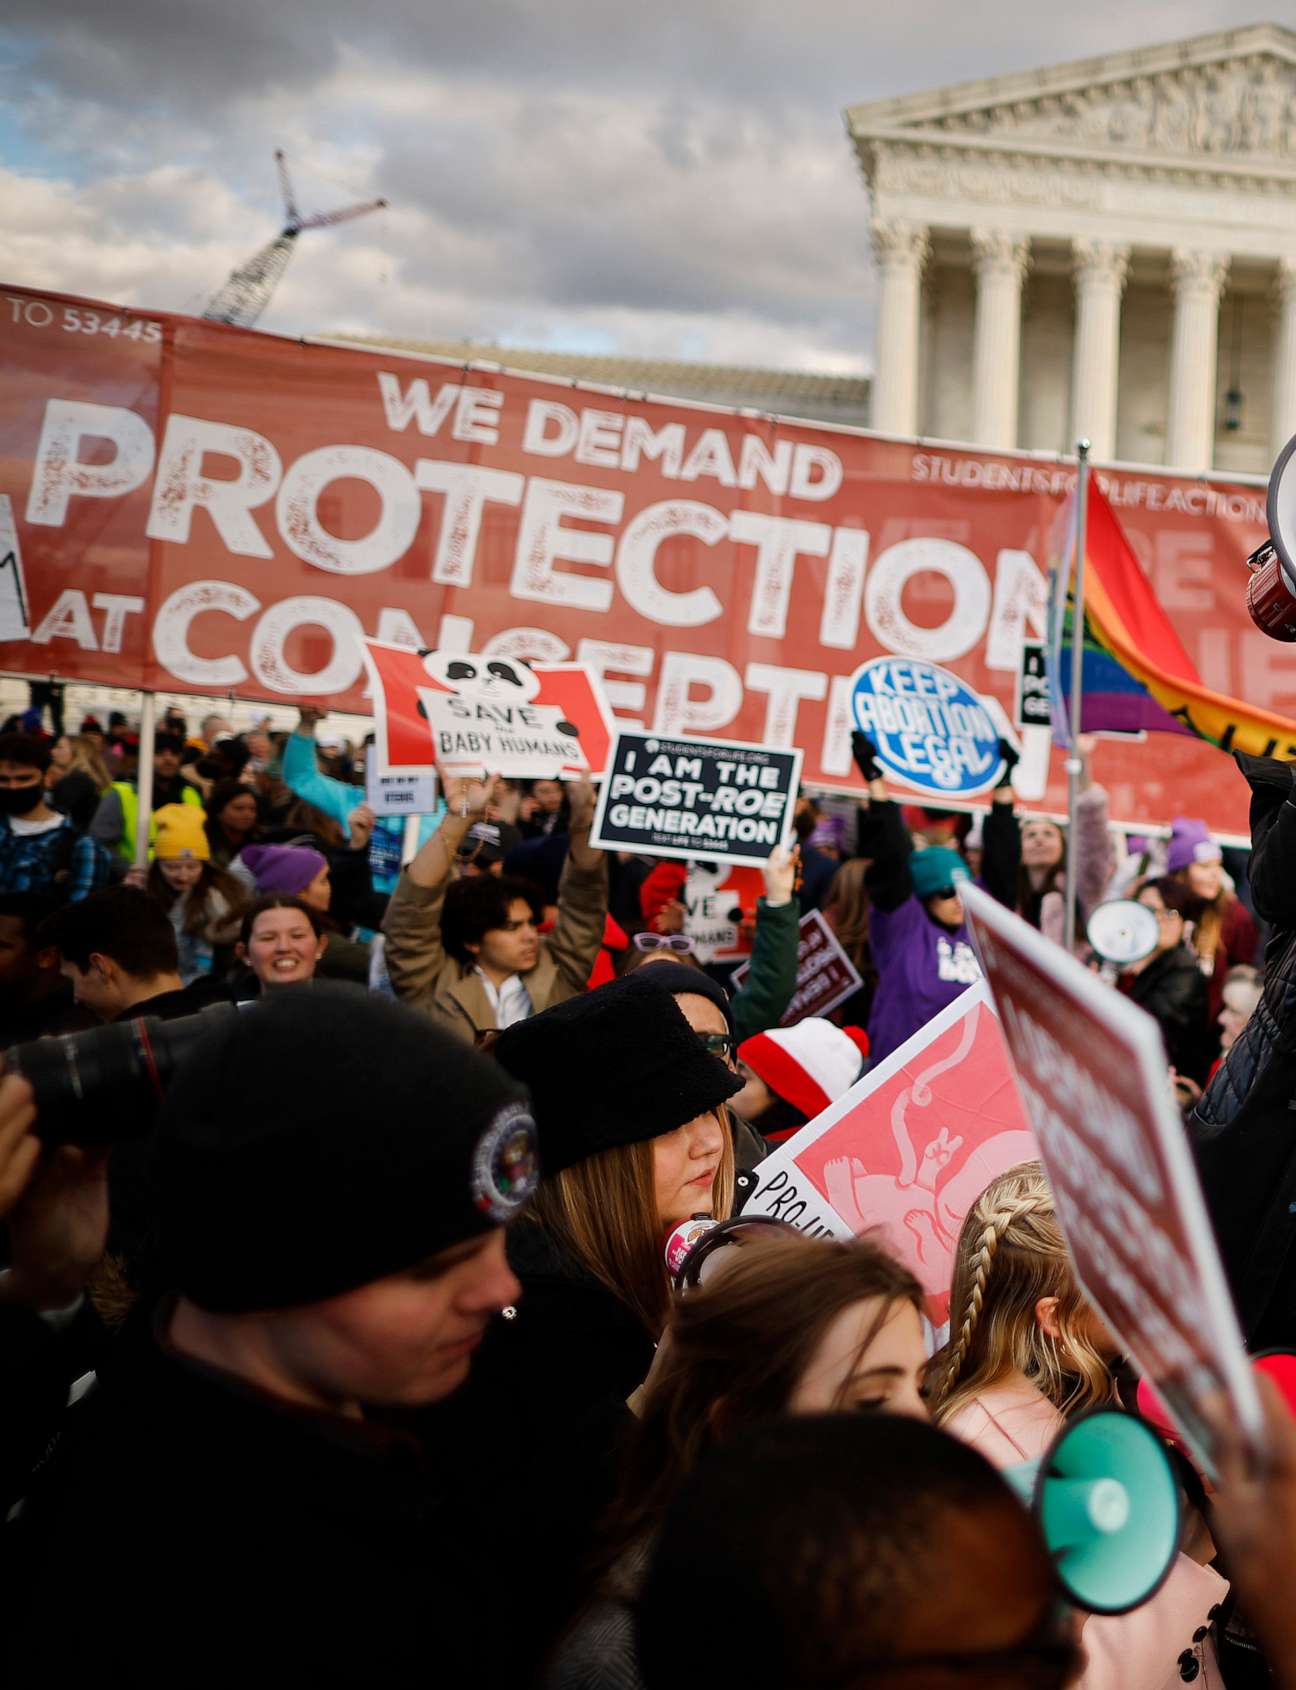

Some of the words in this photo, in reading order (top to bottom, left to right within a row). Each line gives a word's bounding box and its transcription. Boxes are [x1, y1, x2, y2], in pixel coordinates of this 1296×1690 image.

[9, 299, 53, 328] TO
[62, 309, 163, 343] 53445
[377, 371, 502, 445] WE
[523, 400, 842, 500] DEMAND
[26, 399, 1050, 672] PROTECTION
[31, 588, 145, 652] AT
[868, 662, 960, 699] KEEP
[447, 698, 544, 730] SAVE
[854, 691, 996, 743] ABORTION
[439, 729, 494, 756] BABY
[500, 735, 580, 761] HUMANS
[876, 732, 993, 776] LEGAL
[624, 751, 637, 772] I
[648, 754, 703, 780] AM
[716, 761, 781, 790] THE
[610, 773, 787, 819] POST-ROE
[608, 803, 779, 845] GENERATION
